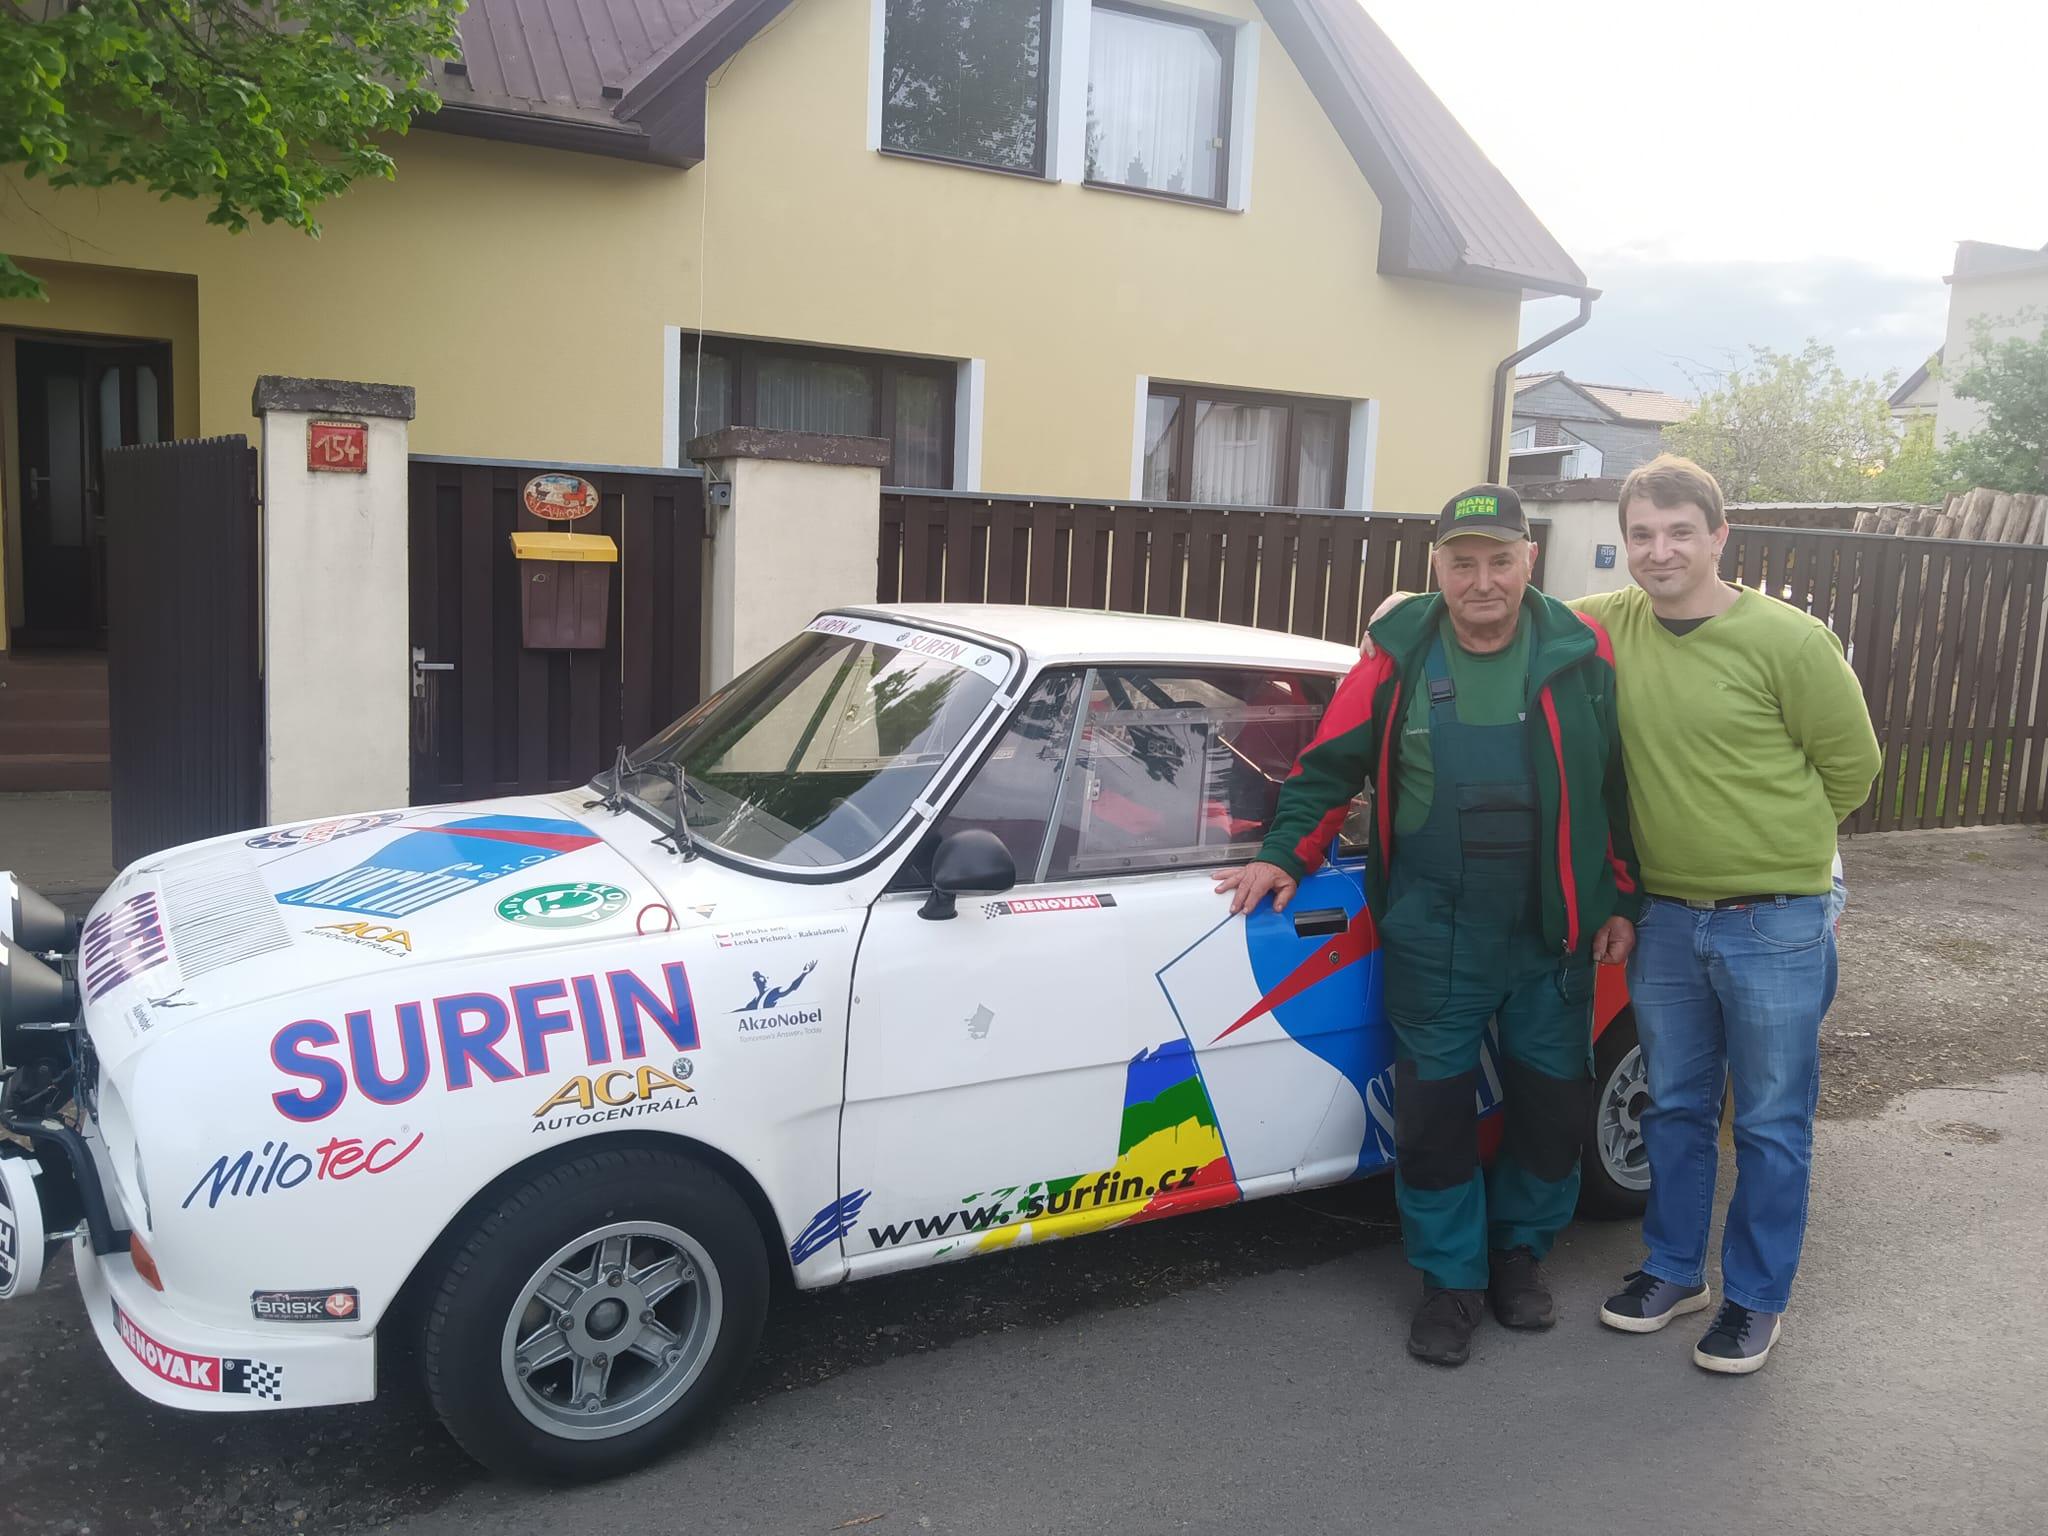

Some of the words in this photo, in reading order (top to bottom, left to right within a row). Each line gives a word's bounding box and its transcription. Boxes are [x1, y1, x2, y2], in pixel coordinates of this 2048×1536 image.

[314, 434, 360, 462] 154
[1456, 505, 1494, 517] FILTER
[904, 634, 968, 662] SURFIN
[1011, 895, 1096, 913] RENOVAK
[314, 921, 412, 953] ACA
[737, 1008, 822, 1033] AkzoNobel
[270, 961, 702, 1123] SURFIN
[532, 1064, 697, 1119] ACA
[531, 1095, 699, 1134] AUTOCENTRÁLA
[256, 1301, 323, 1314] BRISK
[120, 1313, 213, 1387] RENOVAK
